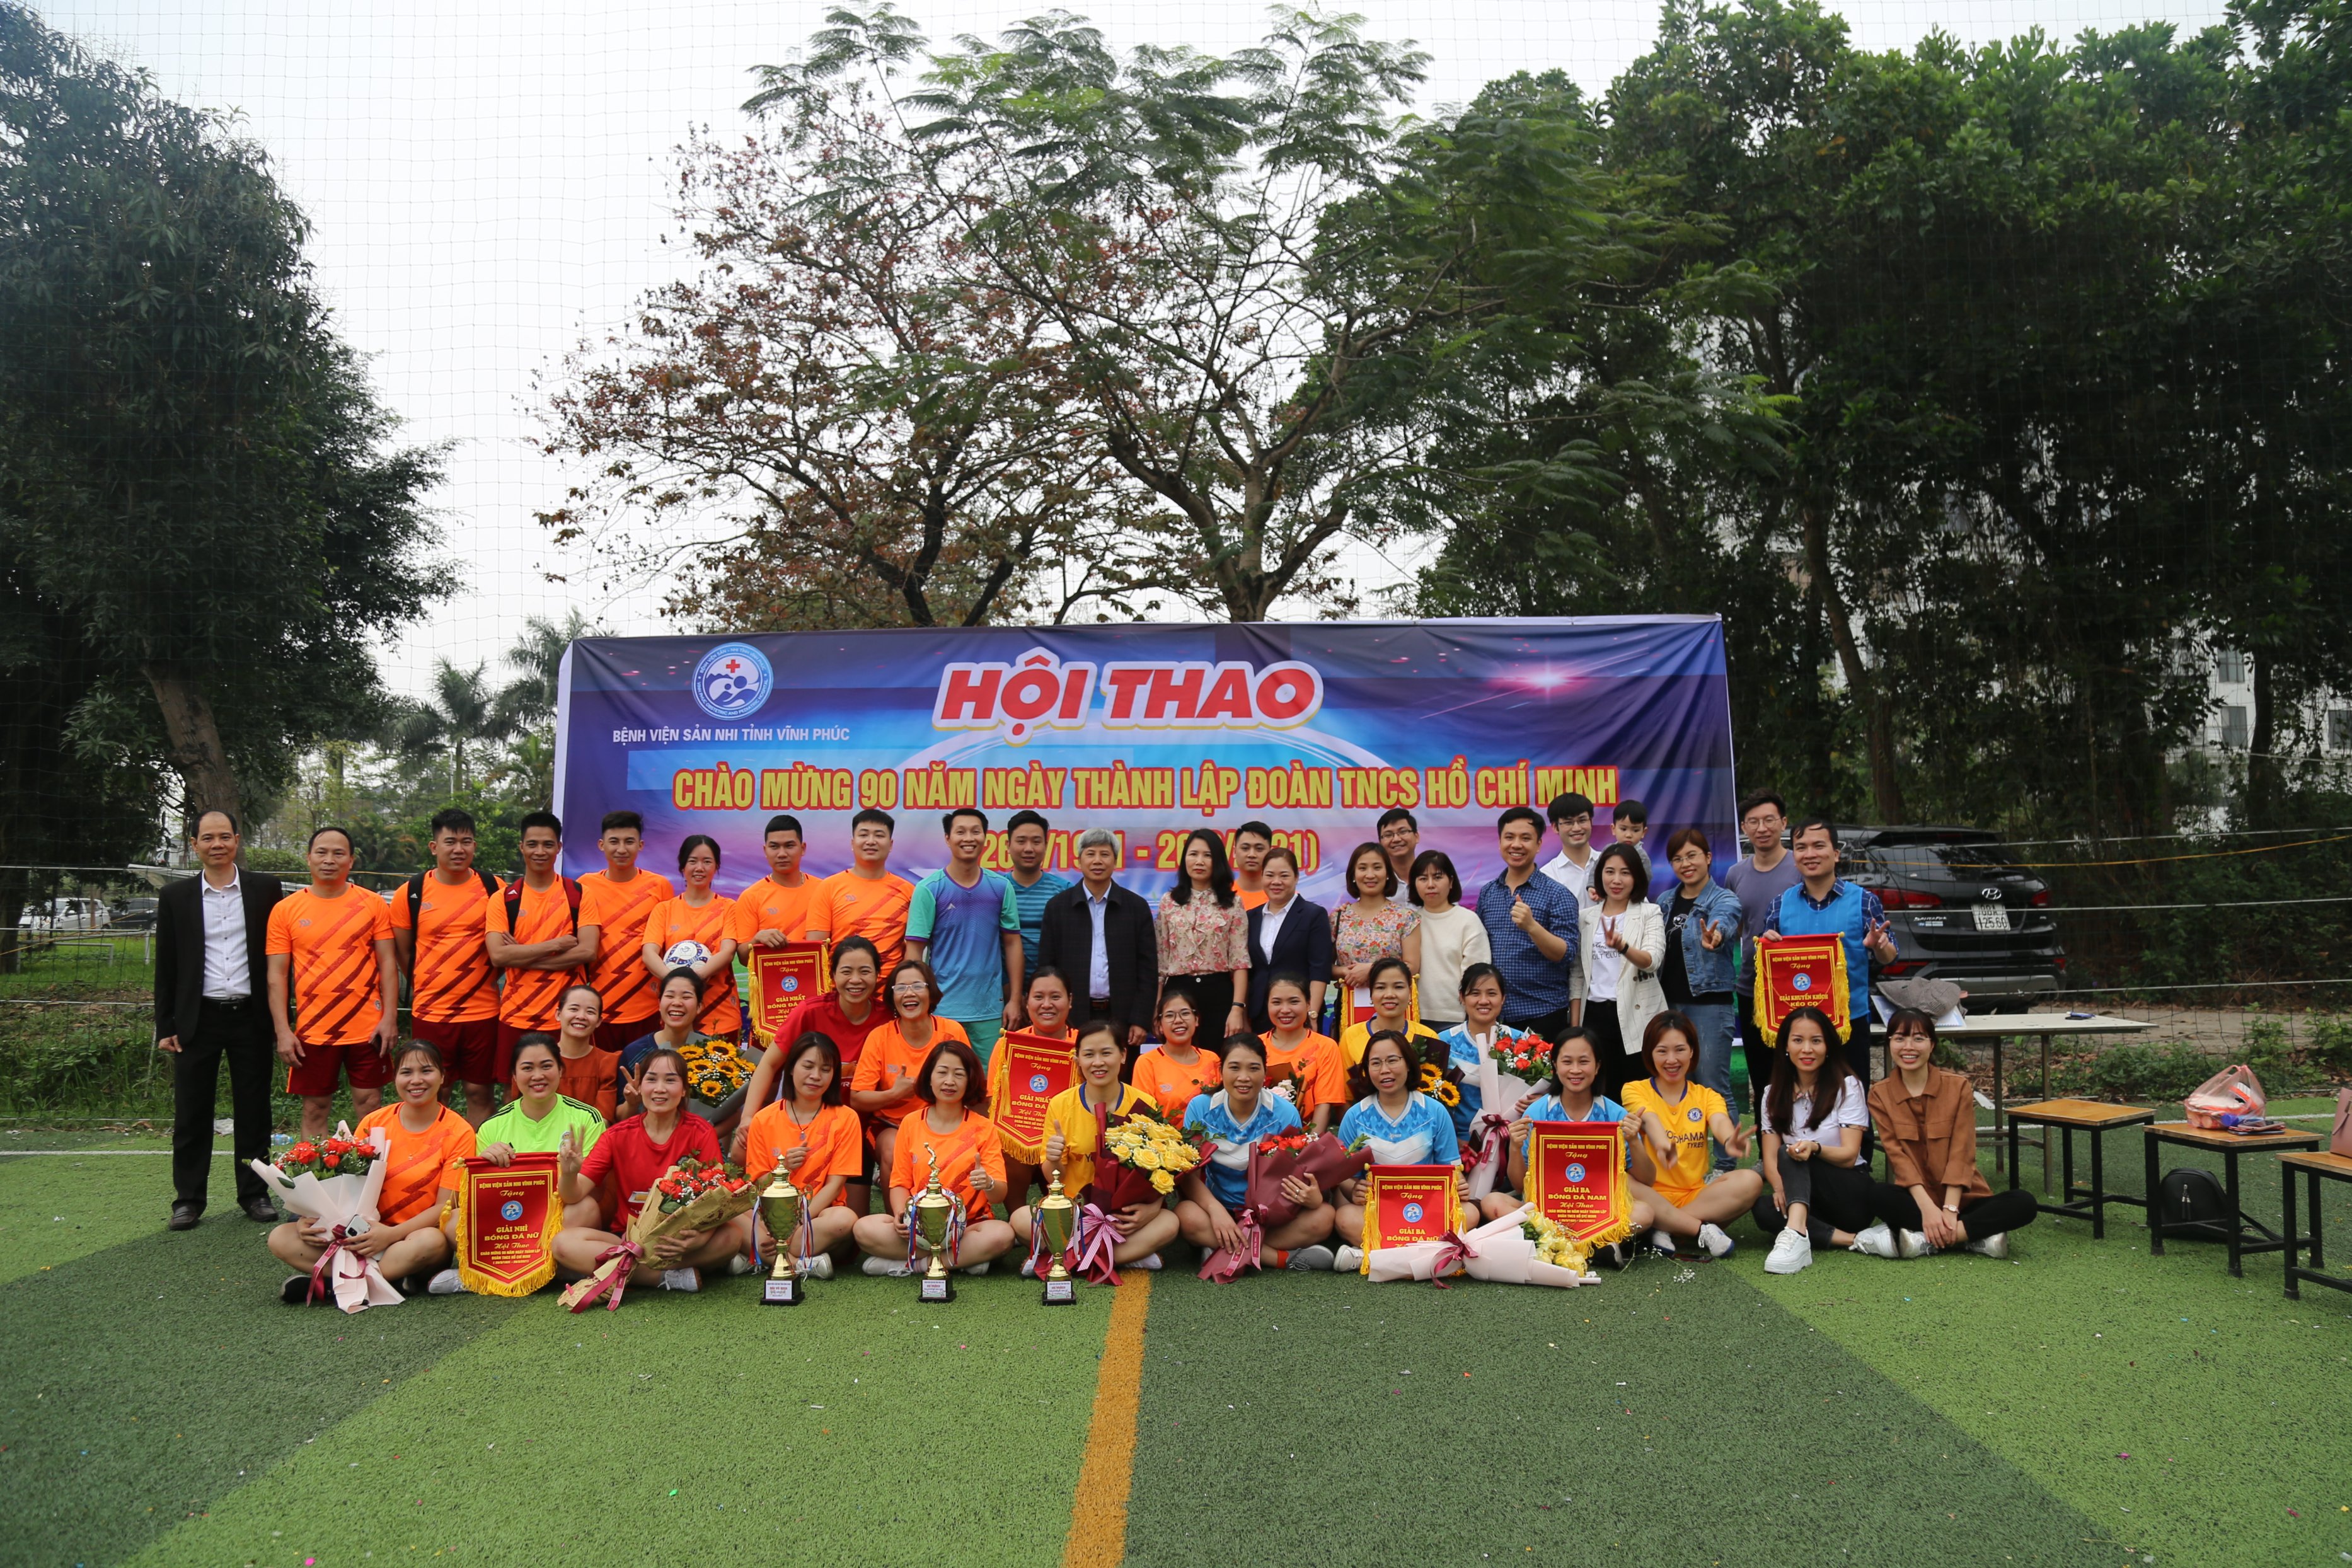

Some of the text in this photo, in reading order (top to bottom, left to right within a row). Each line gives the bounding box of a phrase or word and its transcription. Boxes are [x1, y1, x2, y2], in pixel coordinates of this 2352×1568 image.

[705, 702, 728, 716] OBSTETRIC
[739, 700, 760, 714] PEDIATRIC
[758, 679, 769, 701] HOSPITAL
[937, 651, 1319, 739] HỘI THAO
[613, 723, 850, 746] BỆNH VIỆN SẢN NHI TỈNH VĨNH PHÚC
[674, 756, 1618, 815] CHÀO MỪNG 90 NĂM NGÀY THÀNH LẬP ĐOÀN TNCS HỒ CHÍ MINH
[1136, 847, 1150, 859] -
[496, 1224, 528, 1233] GIẢI NHÌ
